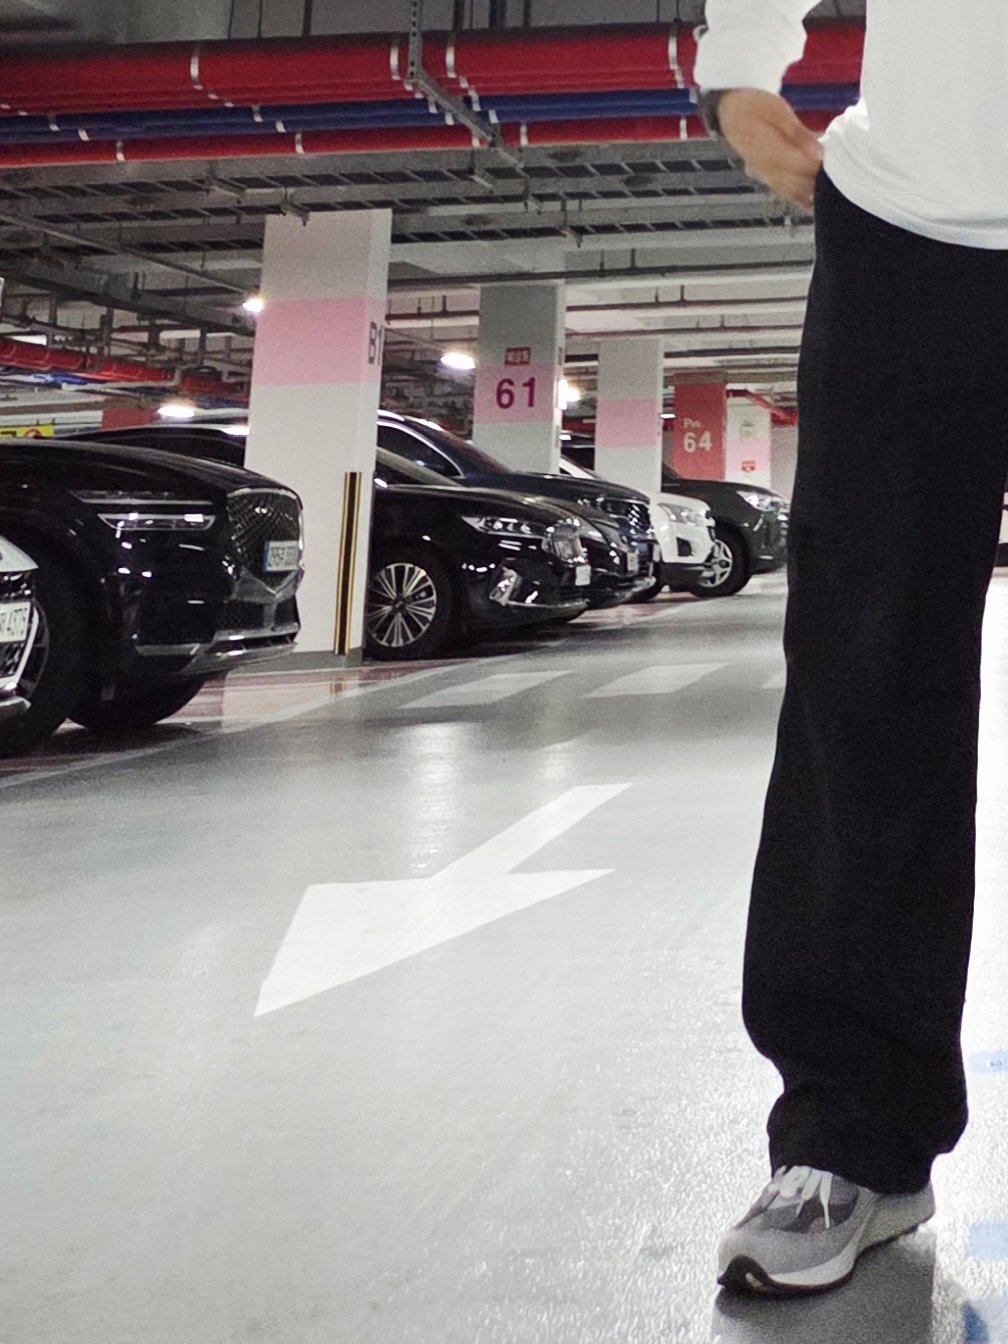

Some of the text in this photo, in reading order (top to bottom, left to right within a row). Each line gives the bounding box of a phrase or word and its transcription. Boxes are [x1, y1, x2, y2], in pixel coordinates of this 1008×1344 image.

[368, 320, 383, 366] B1
[496, 377, 536, 409] 61
[683, 430, 713, 454] 64
